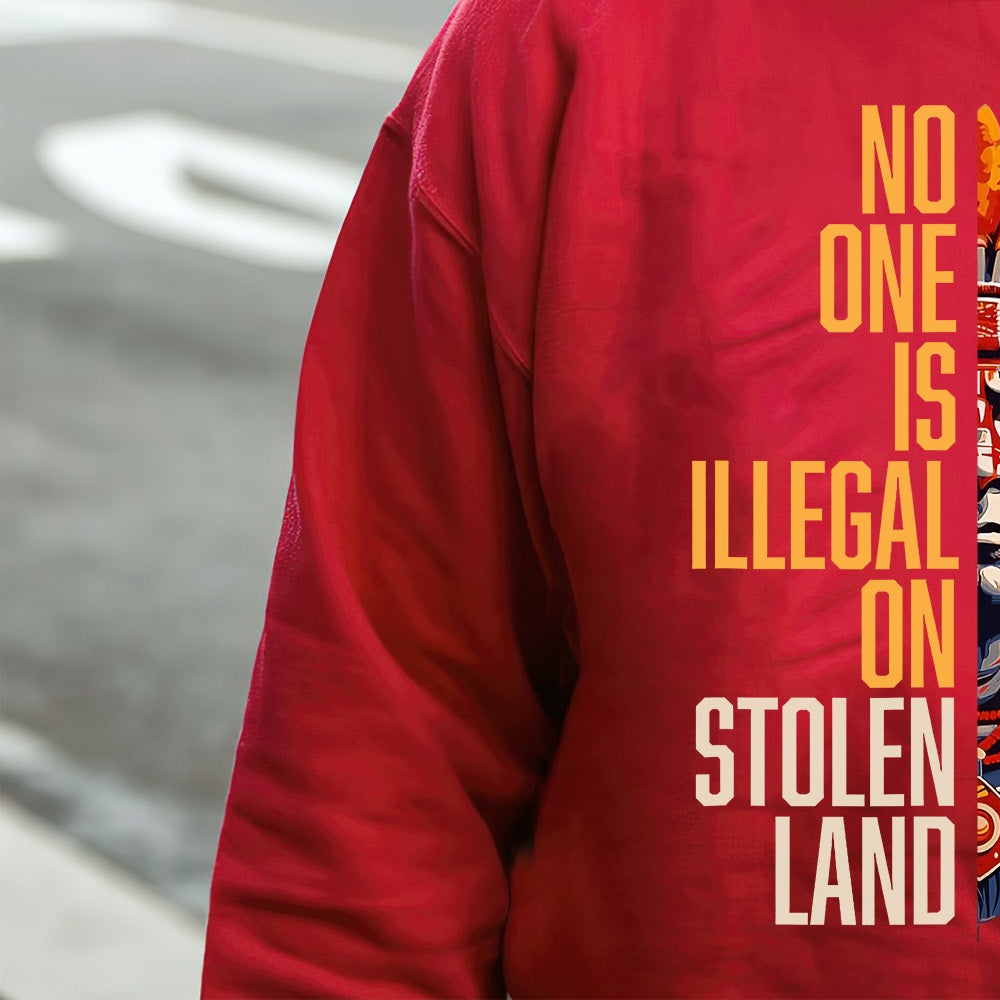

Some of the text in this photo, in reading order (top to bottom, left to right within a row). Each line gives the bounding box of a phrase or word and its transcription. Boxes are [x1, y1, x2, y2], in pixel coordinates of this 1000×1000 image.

[862, 105, 955, 214] NO
[820, 224, 956, 332] ONE
[895, 342, 955, 451] IS
[692, 461, 959, 569] ILLEGAL
[862, 580, 954, 688] ON
[696, 697, 954, 806] STOLEN
[775, 816, 955, 925] LAND
